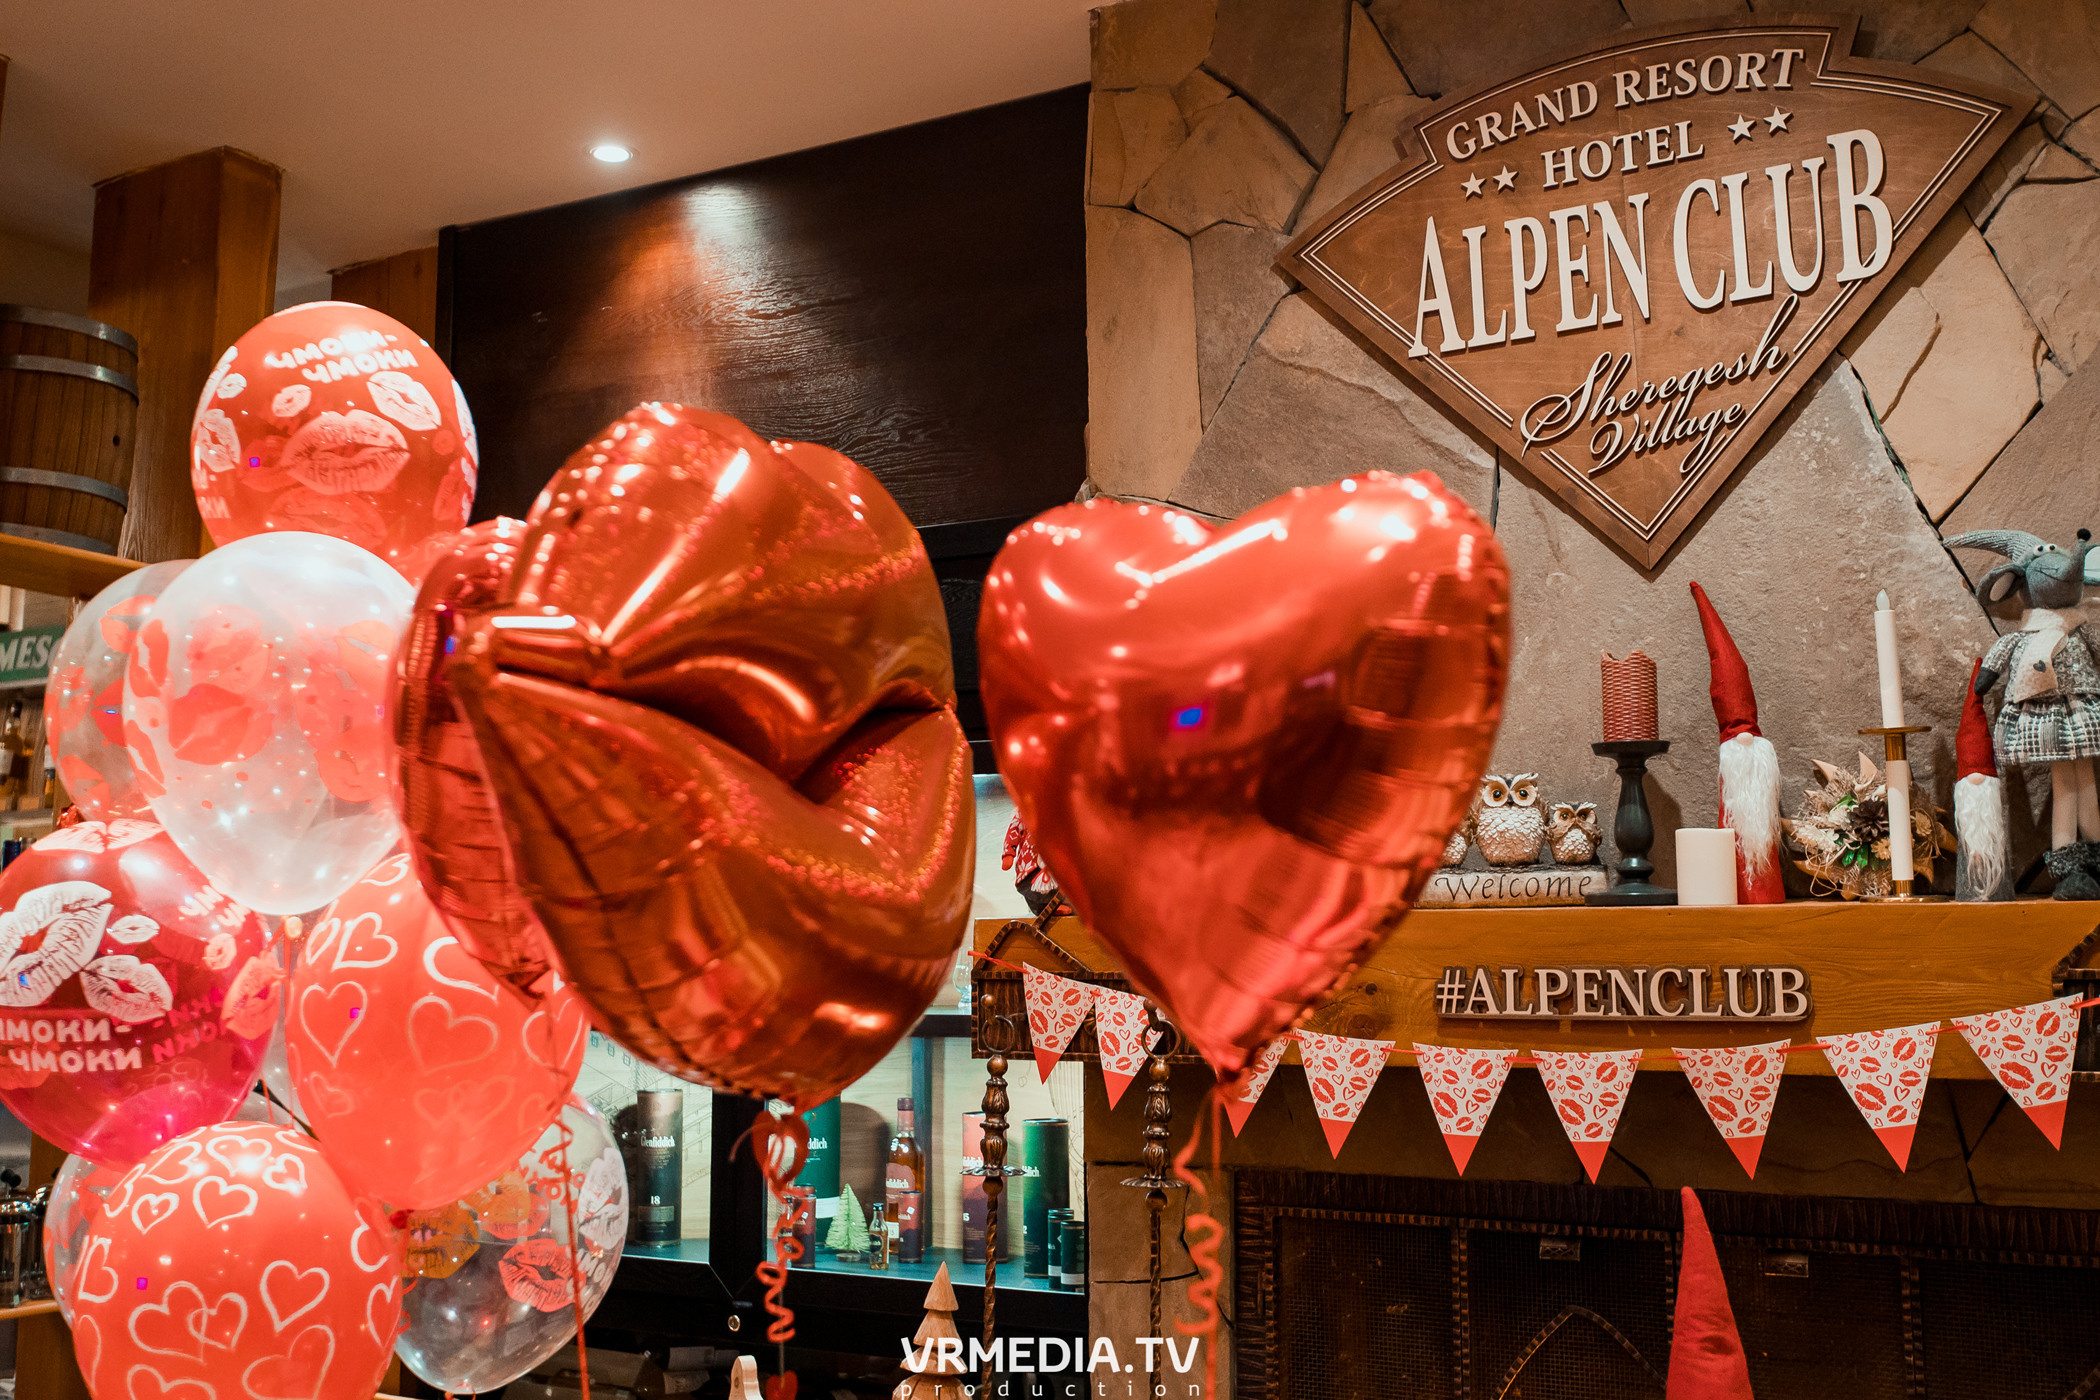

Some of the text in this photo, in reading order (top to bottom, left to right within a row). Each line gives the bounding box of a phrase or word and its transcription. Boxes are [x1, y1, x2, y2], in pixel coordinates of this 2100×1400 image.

[1446, 49, 1803, 160] GRAND RESORT
[1542, 121, 1703, 188] HOTEL
[1409, 130, 1893, 357] ALPEN CLUB
[1520, 294, 1798, 458] Sheregesh
[1588, 397, 1744, 474] Village
[1434, 874, 1592, 900] Welcome
[1437, 968, 1808, 1018] #ALPENCLUB
[9, 1047, 143, 1073] ЧМОКИ
[641, 1135, 676, 1148] Glenfiddich
[650, 1195, 661, 1205] 18
